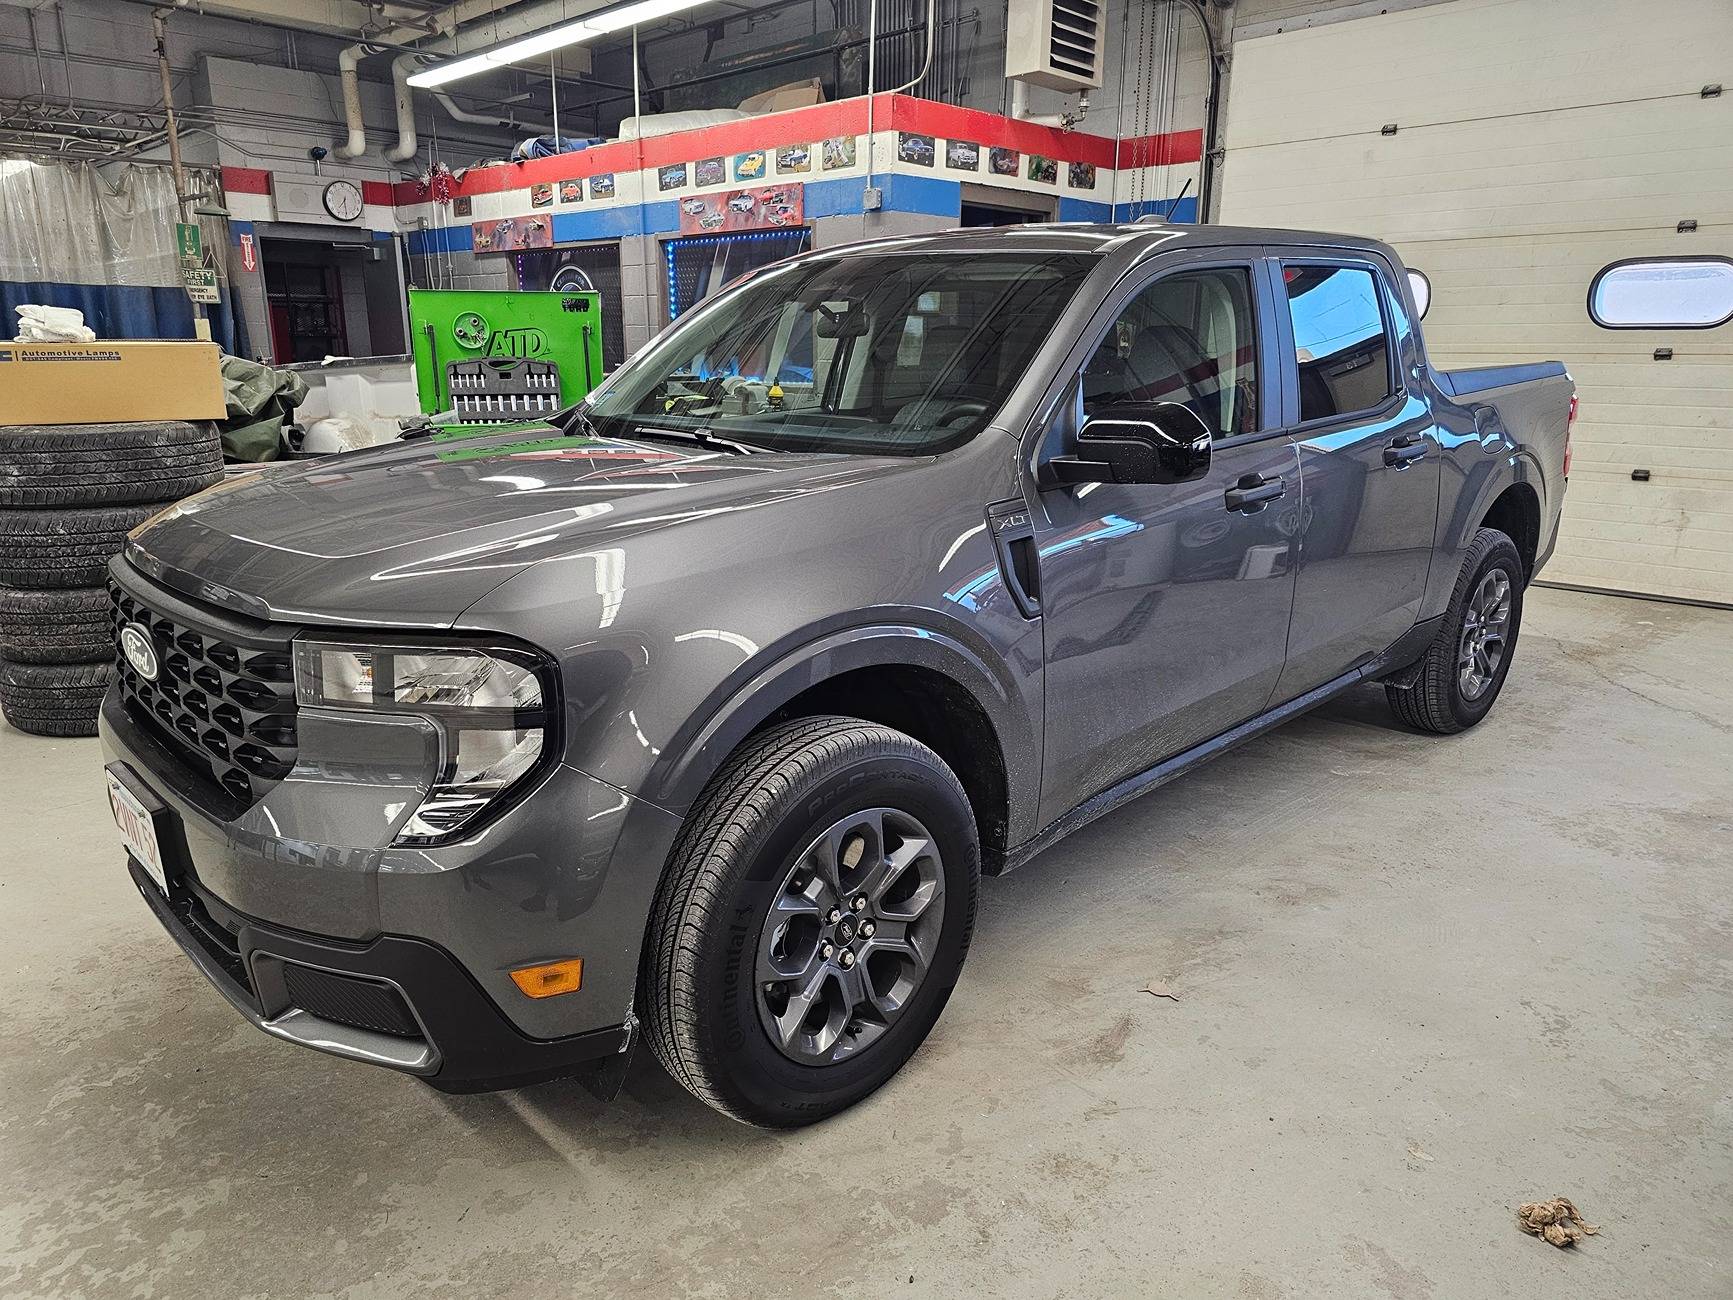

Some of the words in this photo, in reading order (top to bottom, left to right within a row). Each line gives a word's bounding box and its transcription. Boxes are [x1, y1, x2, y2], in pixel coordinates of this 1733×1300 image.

[182, 270, 212, 280] SAFETY
[486, 327, 549, 358] ATD
[86, 350, 120, 358] Lamps
